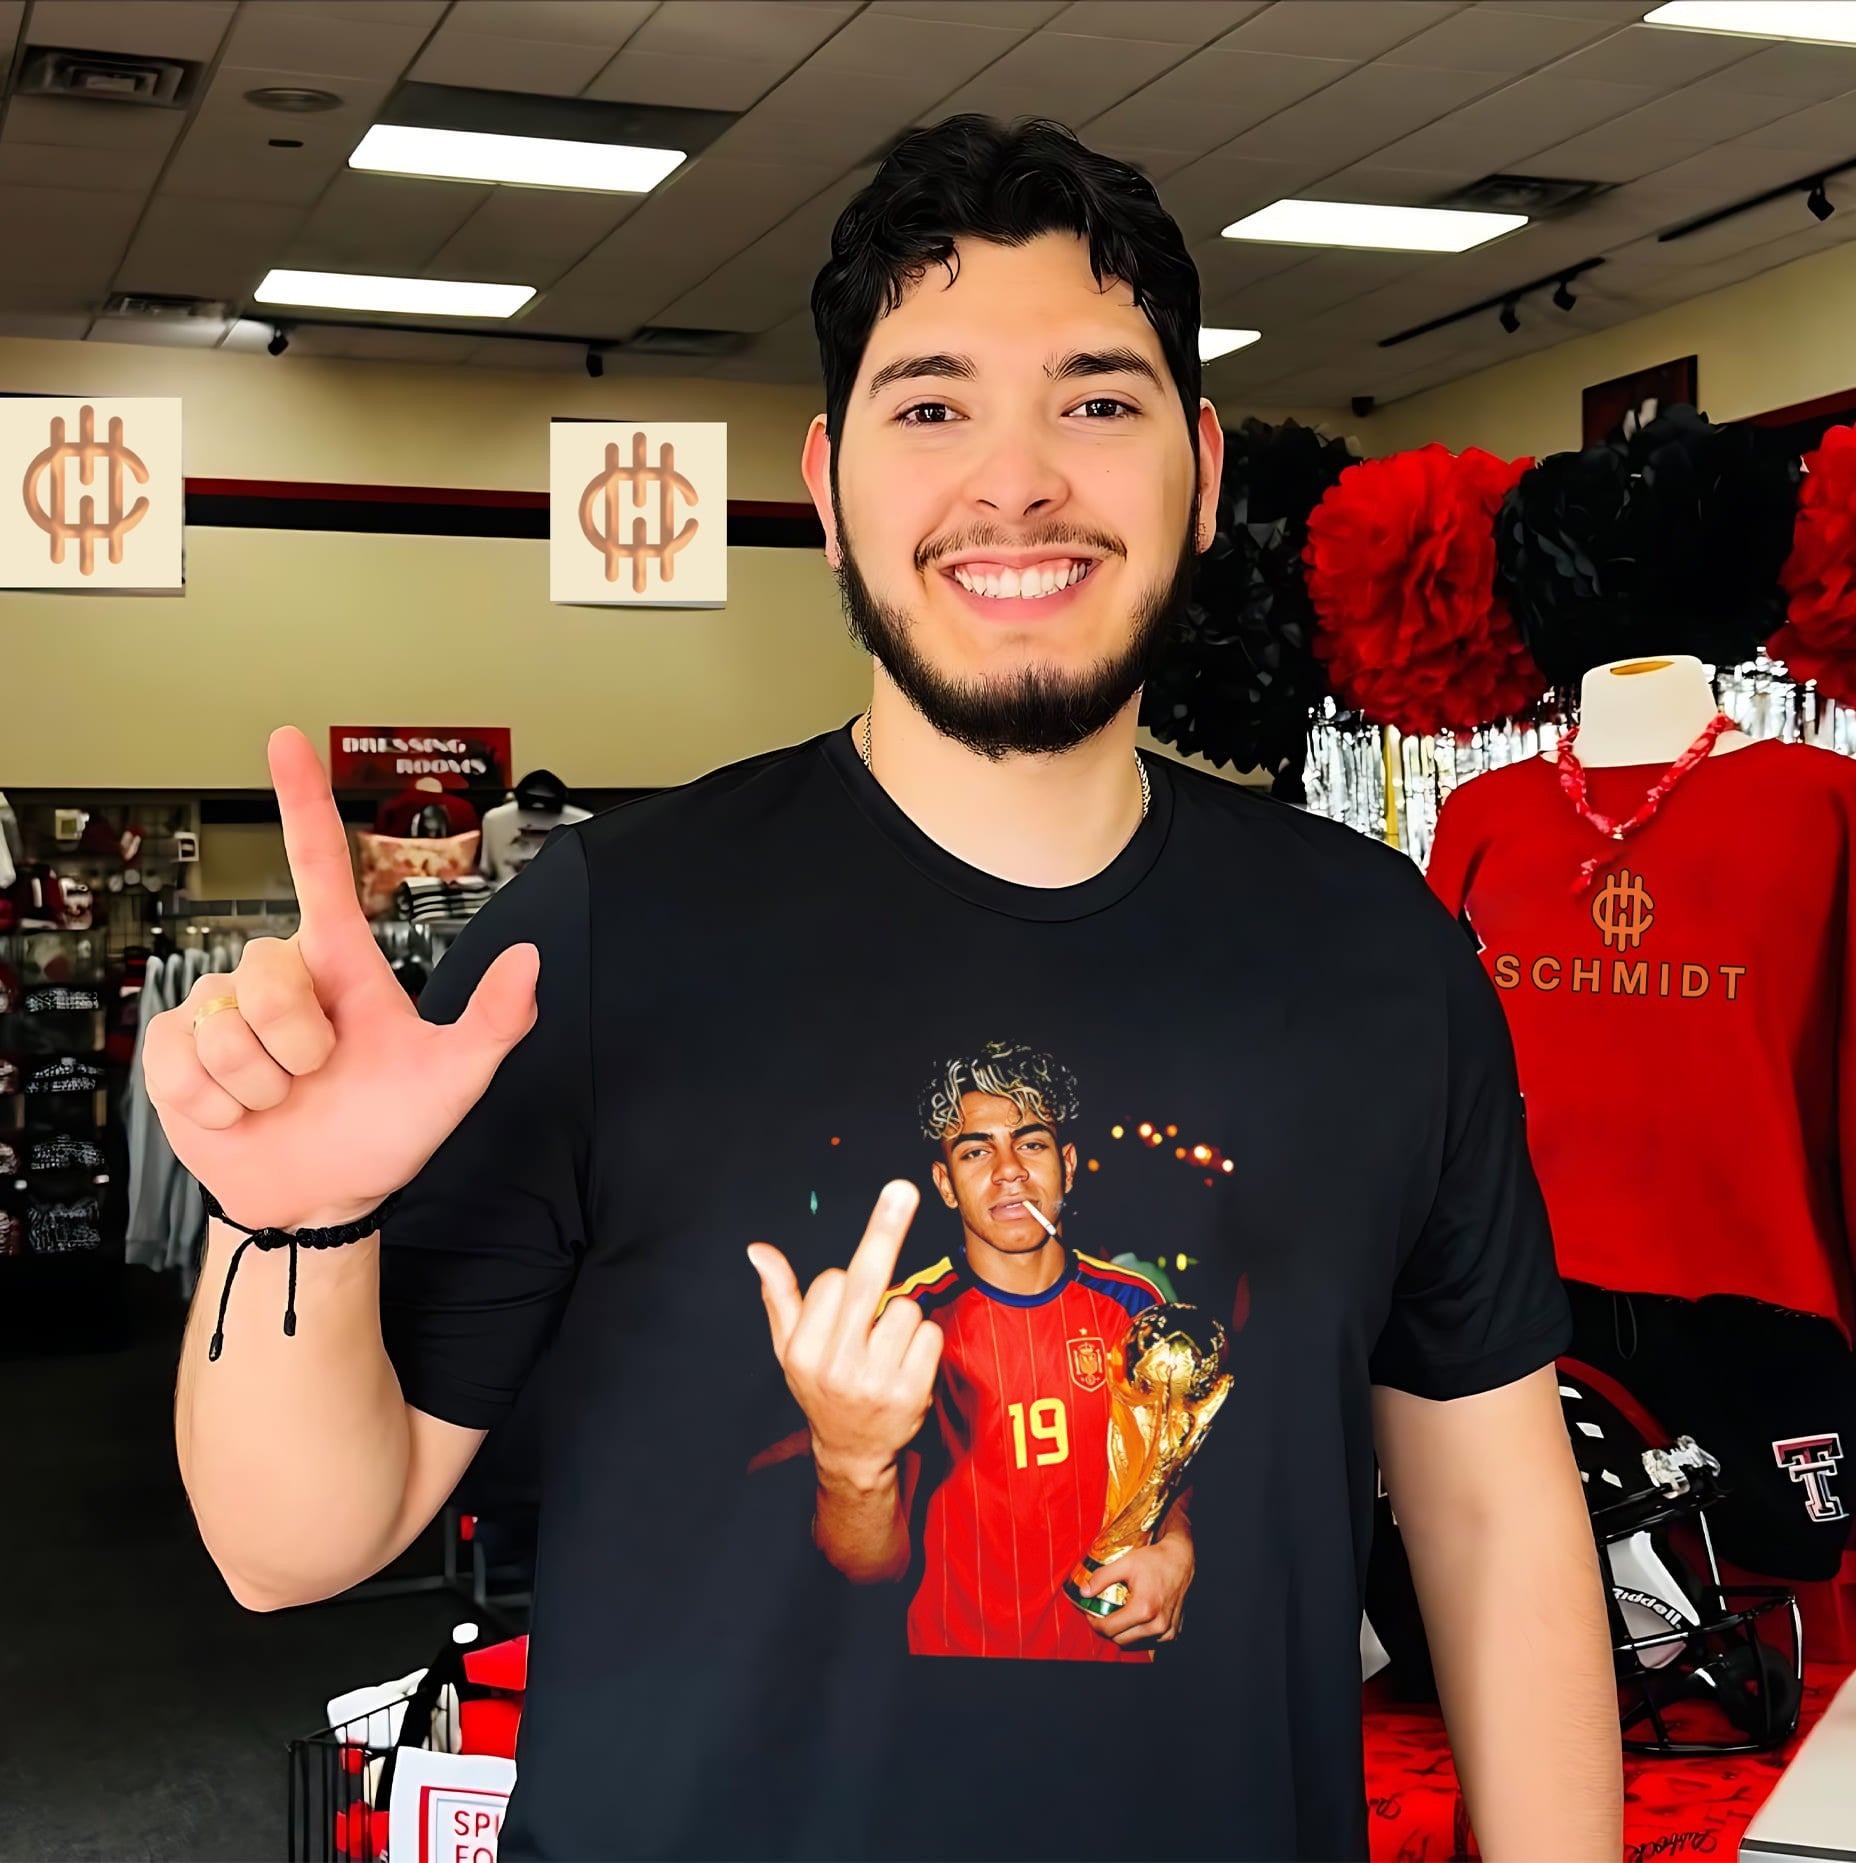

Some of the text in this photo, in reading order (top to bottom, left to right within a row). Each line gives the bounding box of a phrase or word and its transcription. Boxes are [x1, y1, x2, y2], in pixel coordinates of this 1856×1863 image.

[396, 758, 487, 775] ROOMS
[1494, 954, 1747, 1000] SCHMIDT
[1008, 1397, 1070, 1470] 19
